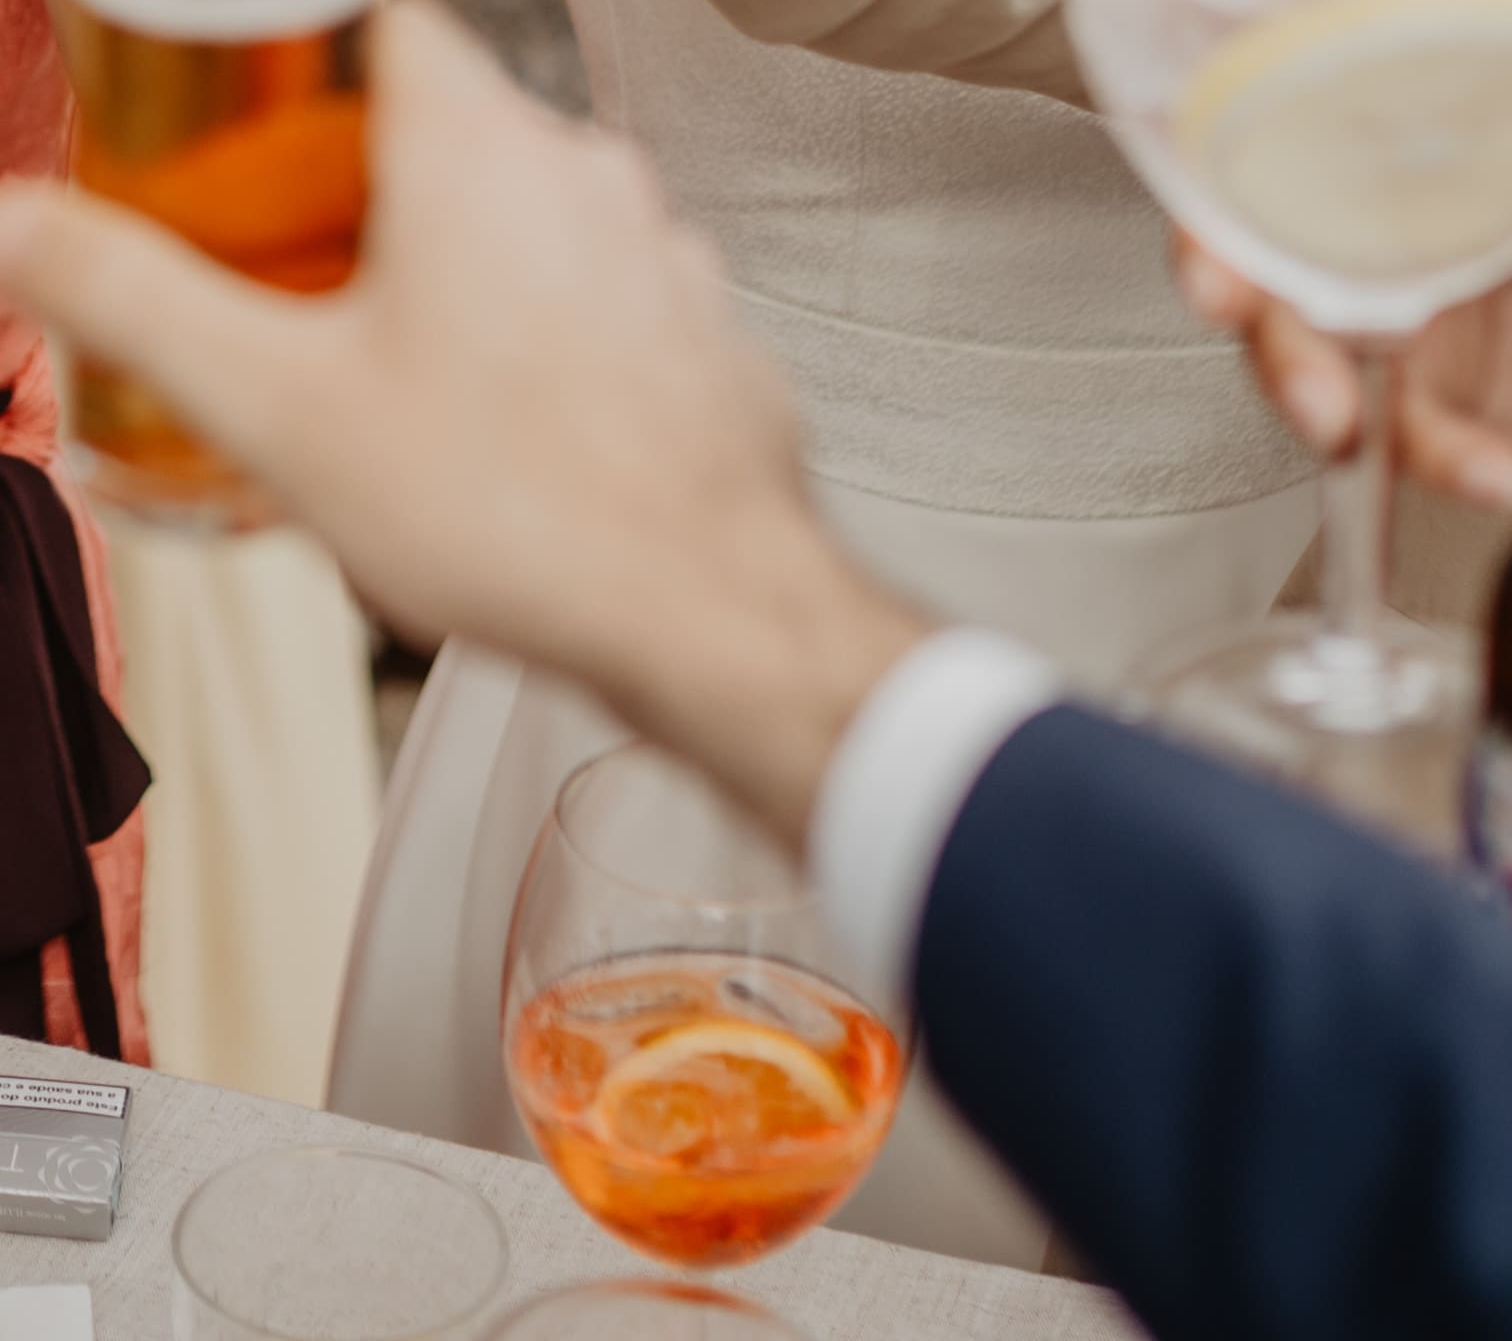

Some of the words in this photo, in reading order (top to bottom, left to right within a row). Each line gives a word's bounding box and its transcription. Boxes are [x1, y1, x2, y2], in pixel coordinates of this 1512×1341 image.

[29, 1084, 72, 1093] saúde
[77, 1089, 103, 1097] sua
[24, 1094, 82, 1105] produto
[86, 1101, 118, 1111] Este
